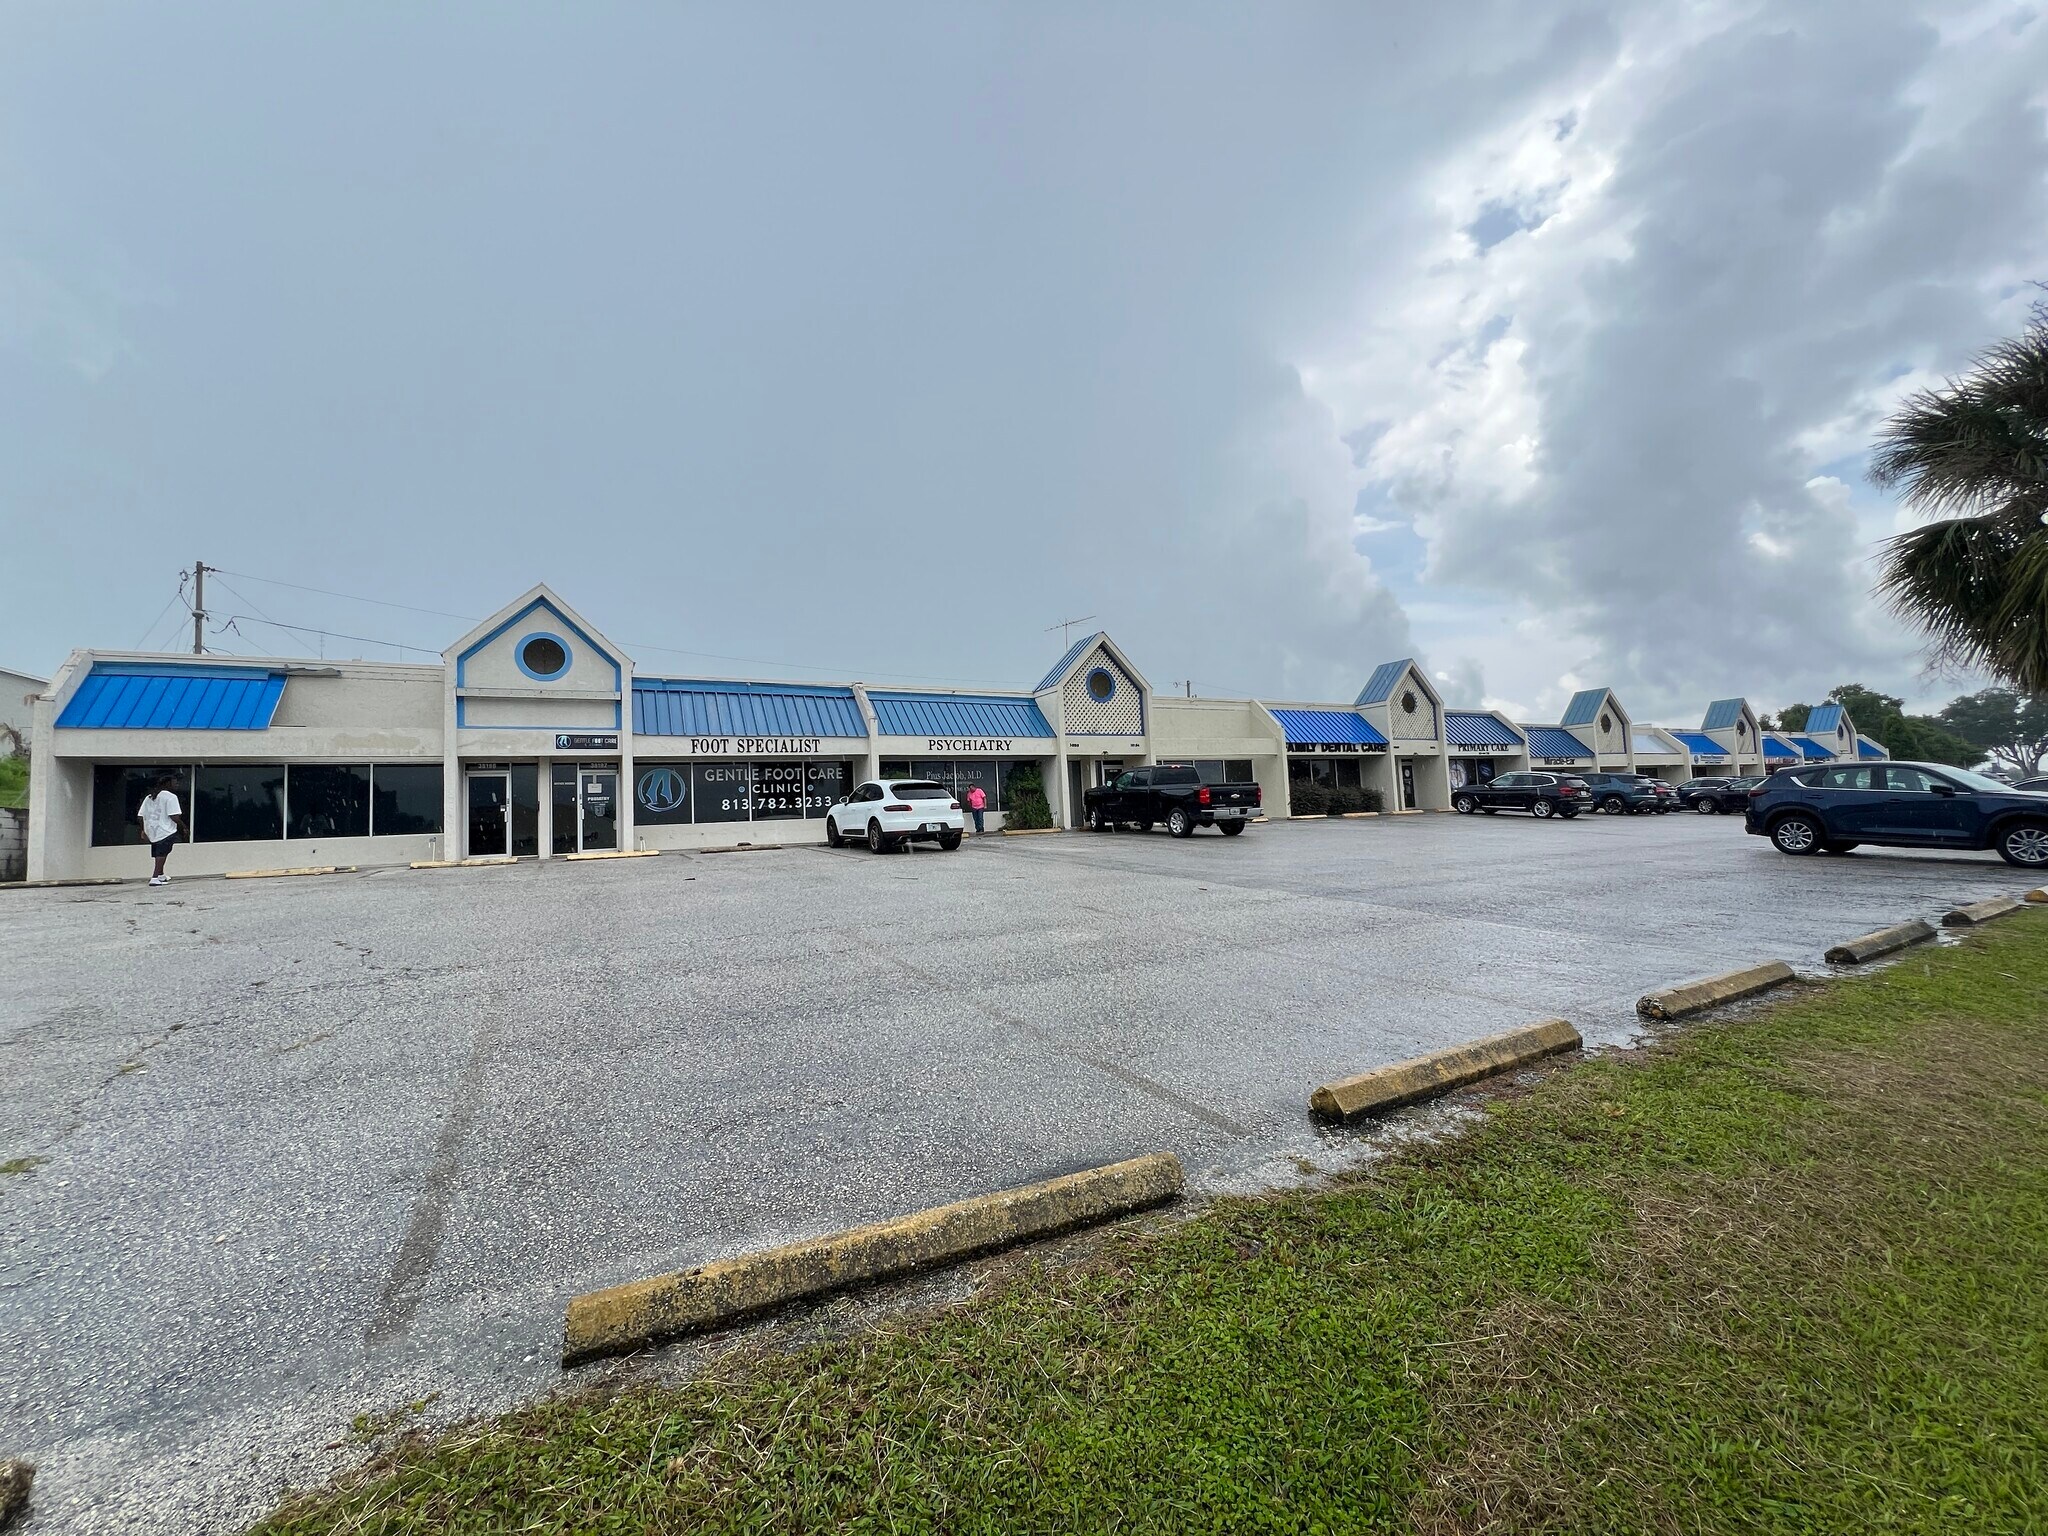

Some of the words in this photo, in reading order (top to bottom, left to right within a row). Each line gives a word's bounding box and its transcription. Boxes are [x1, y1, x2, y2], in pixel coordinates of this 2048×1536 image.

[691, 738, 729, 754] FOOT
[737, 738, 821, 754] SPECIALIST
[928, 740, 1012, 751] PSYCHIATRY
[1286, 743, 1317, 753] AMILY
[1321, 743, 1359, 753] DENTAL
[1361, 743, 1387, 753] CARE
[704, 768, 759, 782] GENTLE
[765, 767, 803, 781] FOOT
[808, 767, 844, 780] CARE
[752, 783, 801, 793] CLINIC
[721, 796, 832, 811] 813.782.3233
